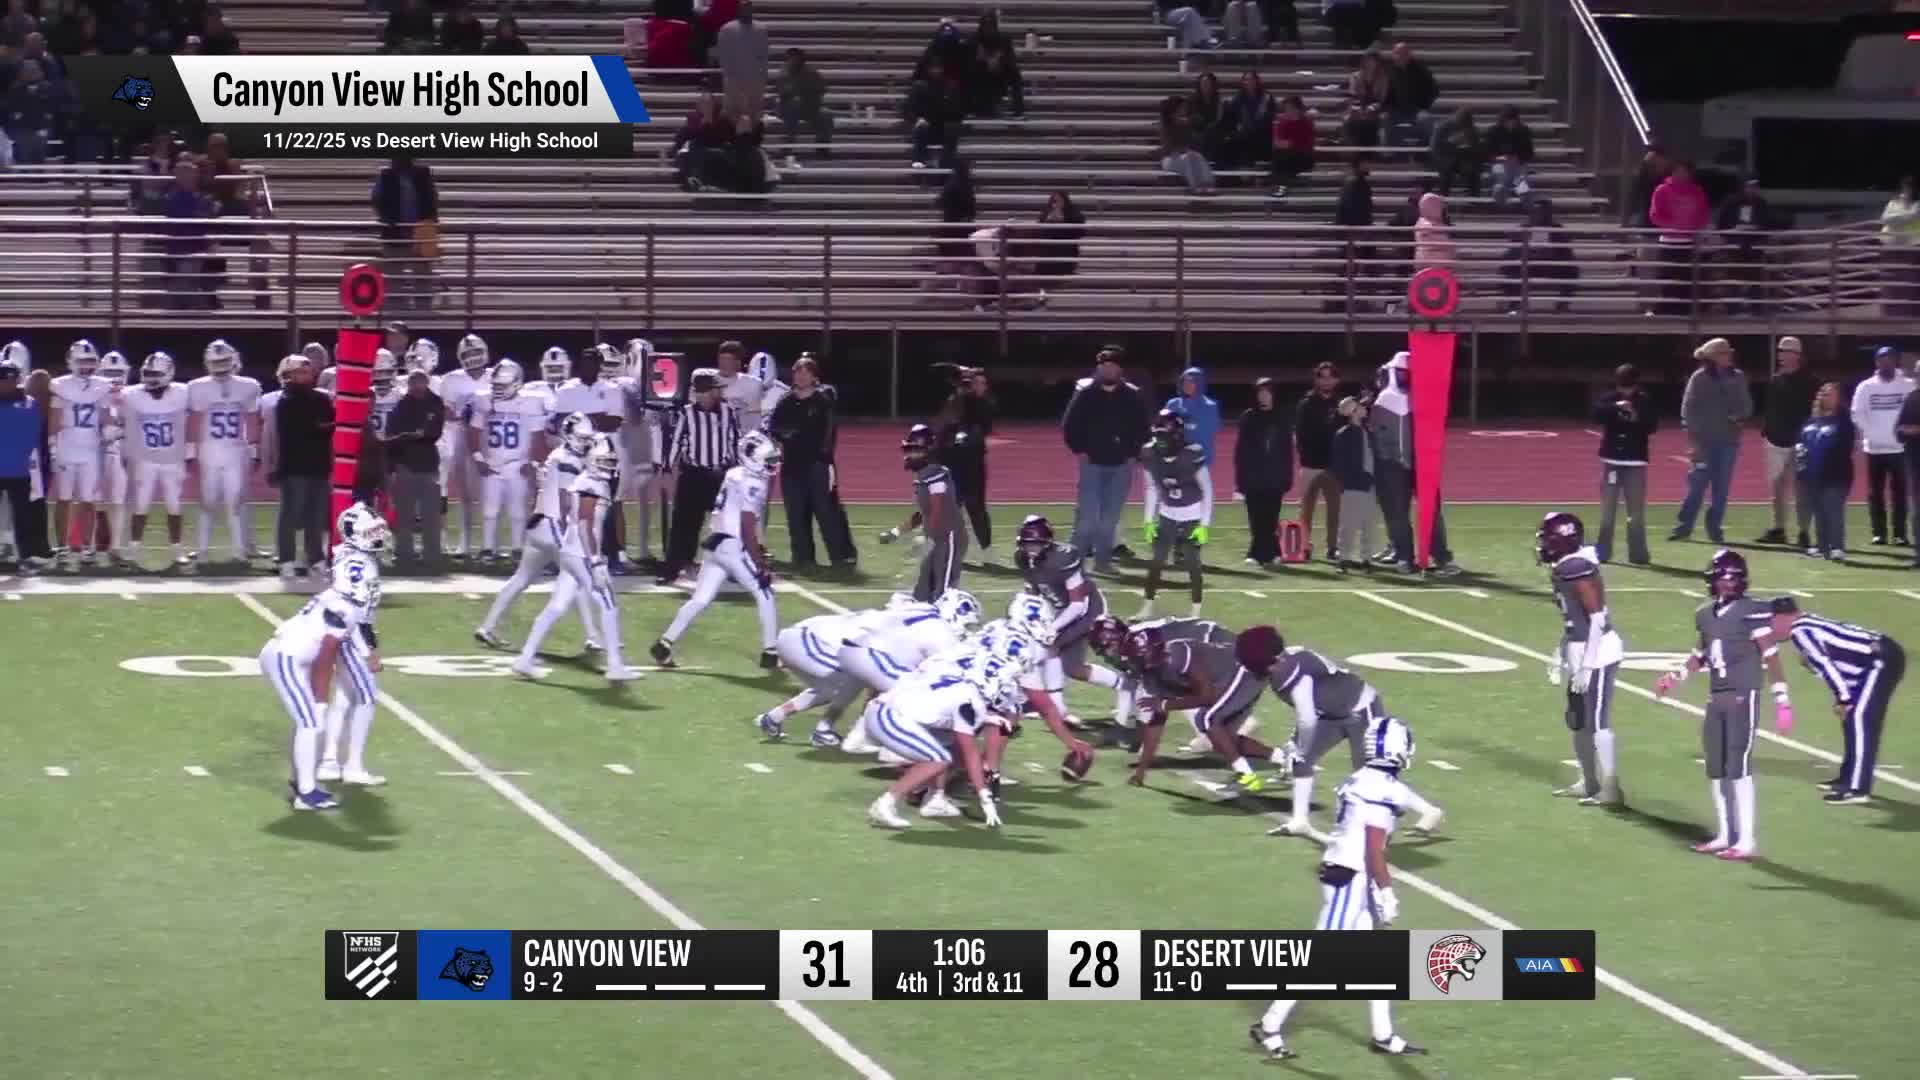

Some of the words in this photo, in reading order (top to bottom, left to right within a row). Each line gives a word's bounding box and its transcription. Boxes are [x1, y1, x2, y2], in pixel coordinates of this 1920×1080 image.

[652, 358, 679, 398] 3
[72, 403, 95, 428] 12
[211, 411, 240, 439] 59
[487, 420, 519, 449] 58
